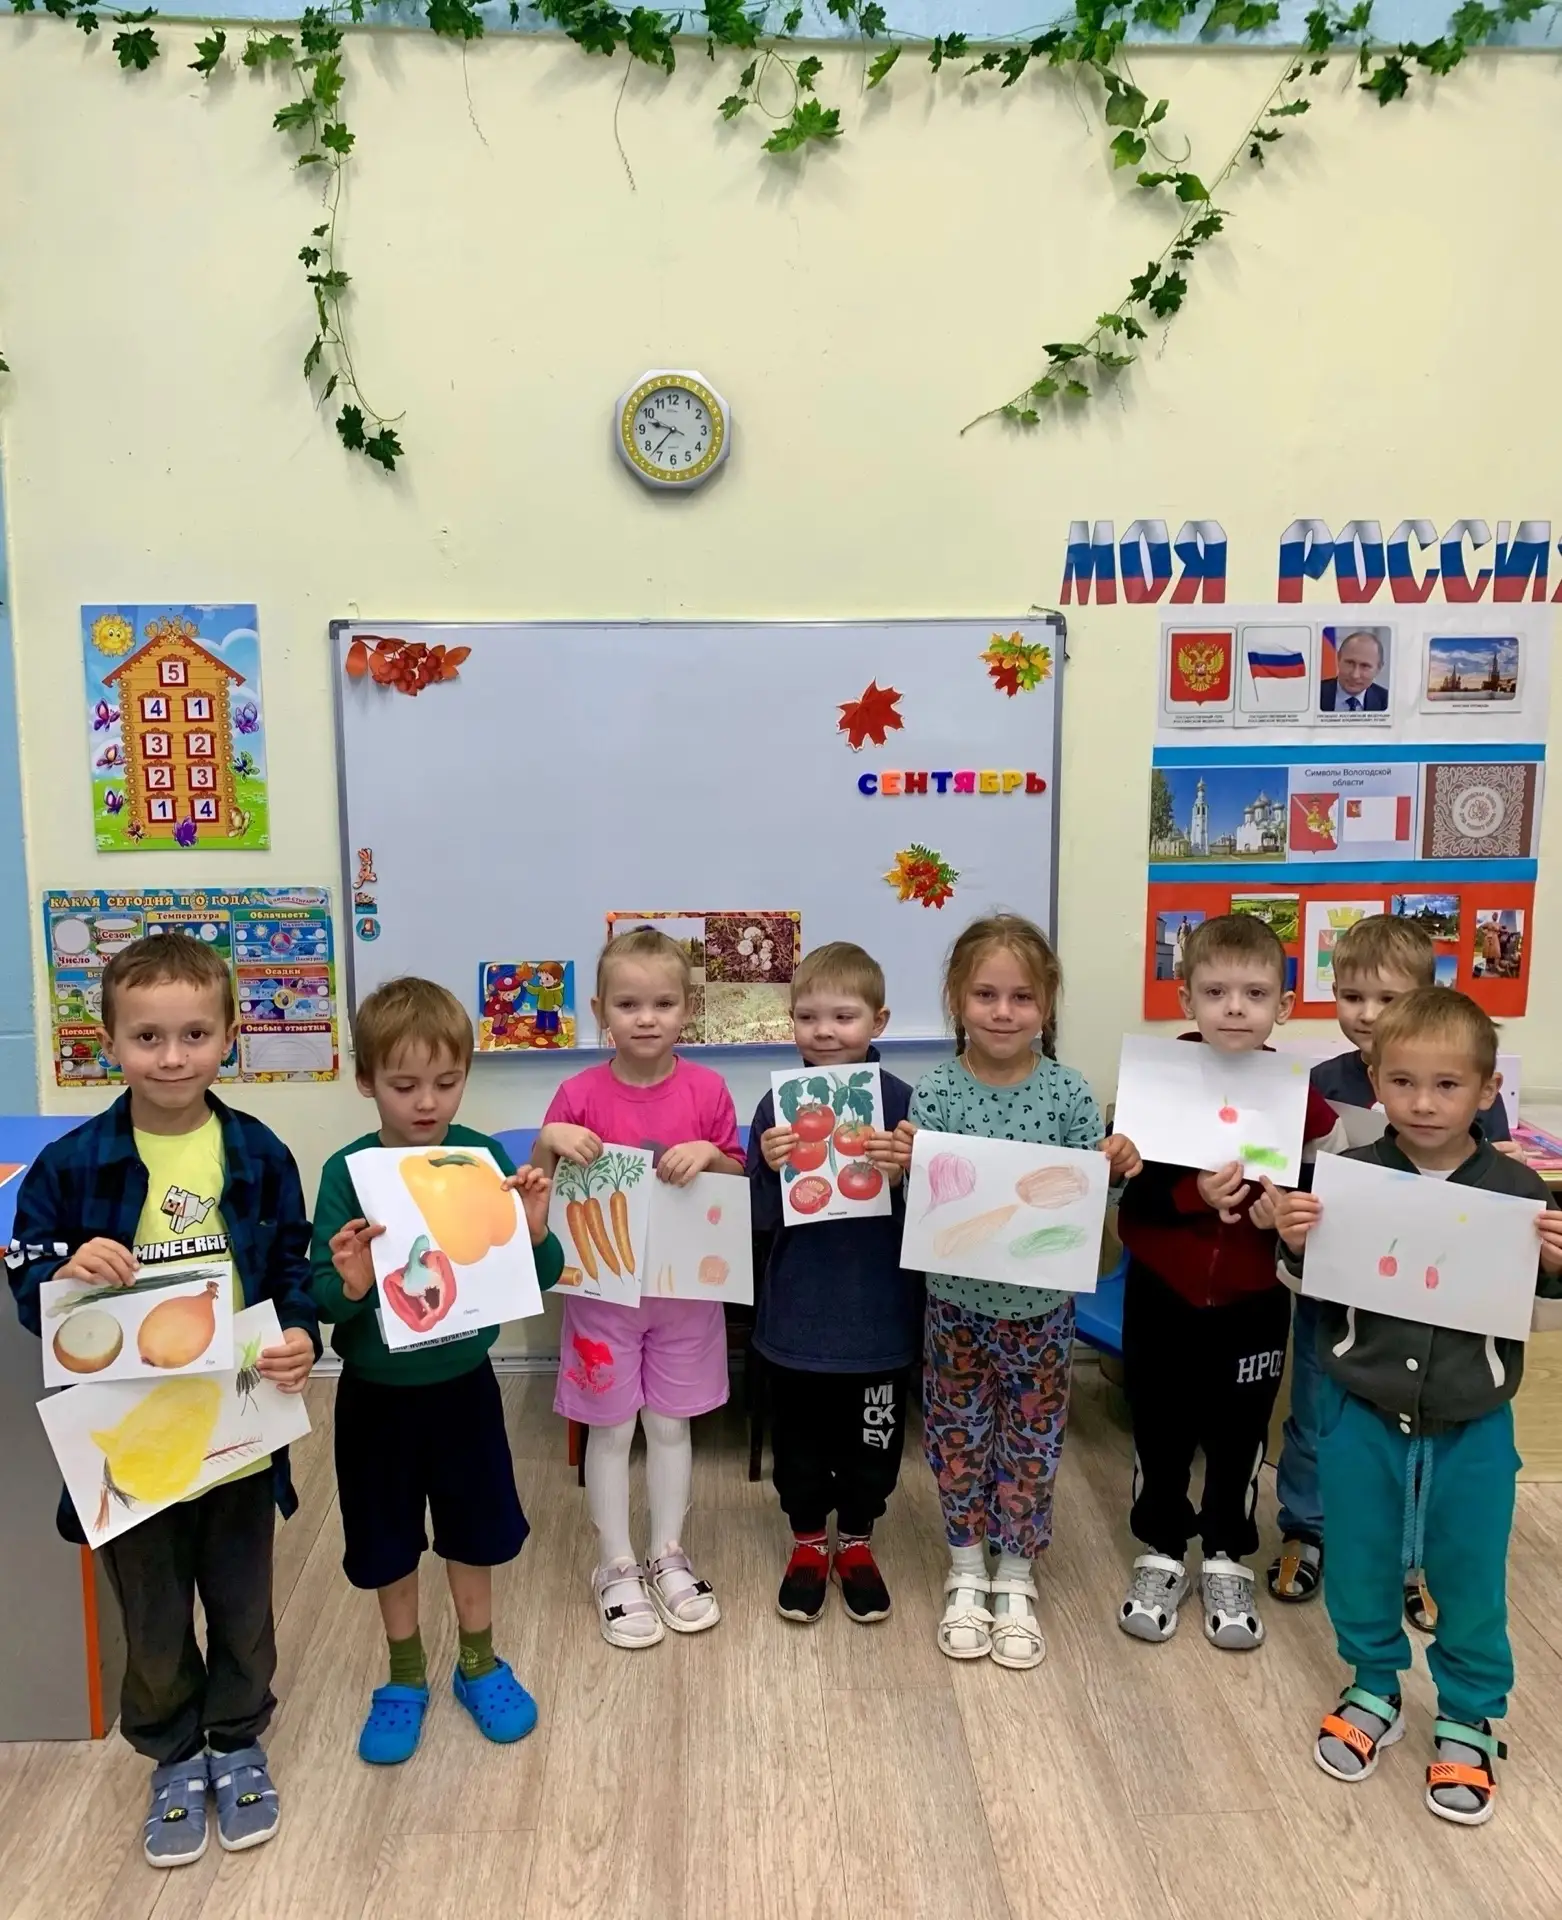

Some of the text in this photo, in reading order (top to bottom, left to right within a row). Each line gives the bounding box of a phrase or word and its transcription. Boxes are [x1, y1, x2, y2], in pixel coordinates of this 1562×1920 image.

[654, 399, 665, 409] 11
[666, 394, 679, 405] 12
[685, 399, 691, 409] 1
[643, 408, 655, 419] 10
[695, 409, 702, 420] 2
[639, 424, 646, 435] 9
[700, 425, 707, 436] 3
[644, 440, 652, 451] 8
[694, 441, 702, 452] 4
[656, 451, 663, 462] 7
[670, 454, 677, 465] 6
[684, 451, 692, 462] 5
[1060, 519, 1562, 605] МОЯ РОССИ
[168, 664, 180, 682] 5
[150, 700, 162, 718] 4
[193, 700, 203, 718] 1
[151, 737, 163, 753] 3
[194, 737, 206, 753] 2
[197, 769, 209, 785] 3
[1304, 767, 1392, 777] Символы Вологодской
[153, 770, 166, 786] 2
[857, 770, 1047, 796] СЕНТЯБРЬ
[1332, 778, 1364, 787] области
[158, 801, 167, 818] 1
[200, 801, 212, 818] 4
[50, 896, 101, 908] КАКАЯ
[107, 896, 175, 908] СЕГОДНЯ
[157, 911, 220, 921] Температура
[250, 911, 310, 919] Облачность
[101, 931, 132, 940] Сезон
[58, 956, 91, 966] Число
[265, 968, 301, 976] Осадки
[246, 1024, 283, 1032] Особые
[132, 1234, 229, 1262] MINECRAF
